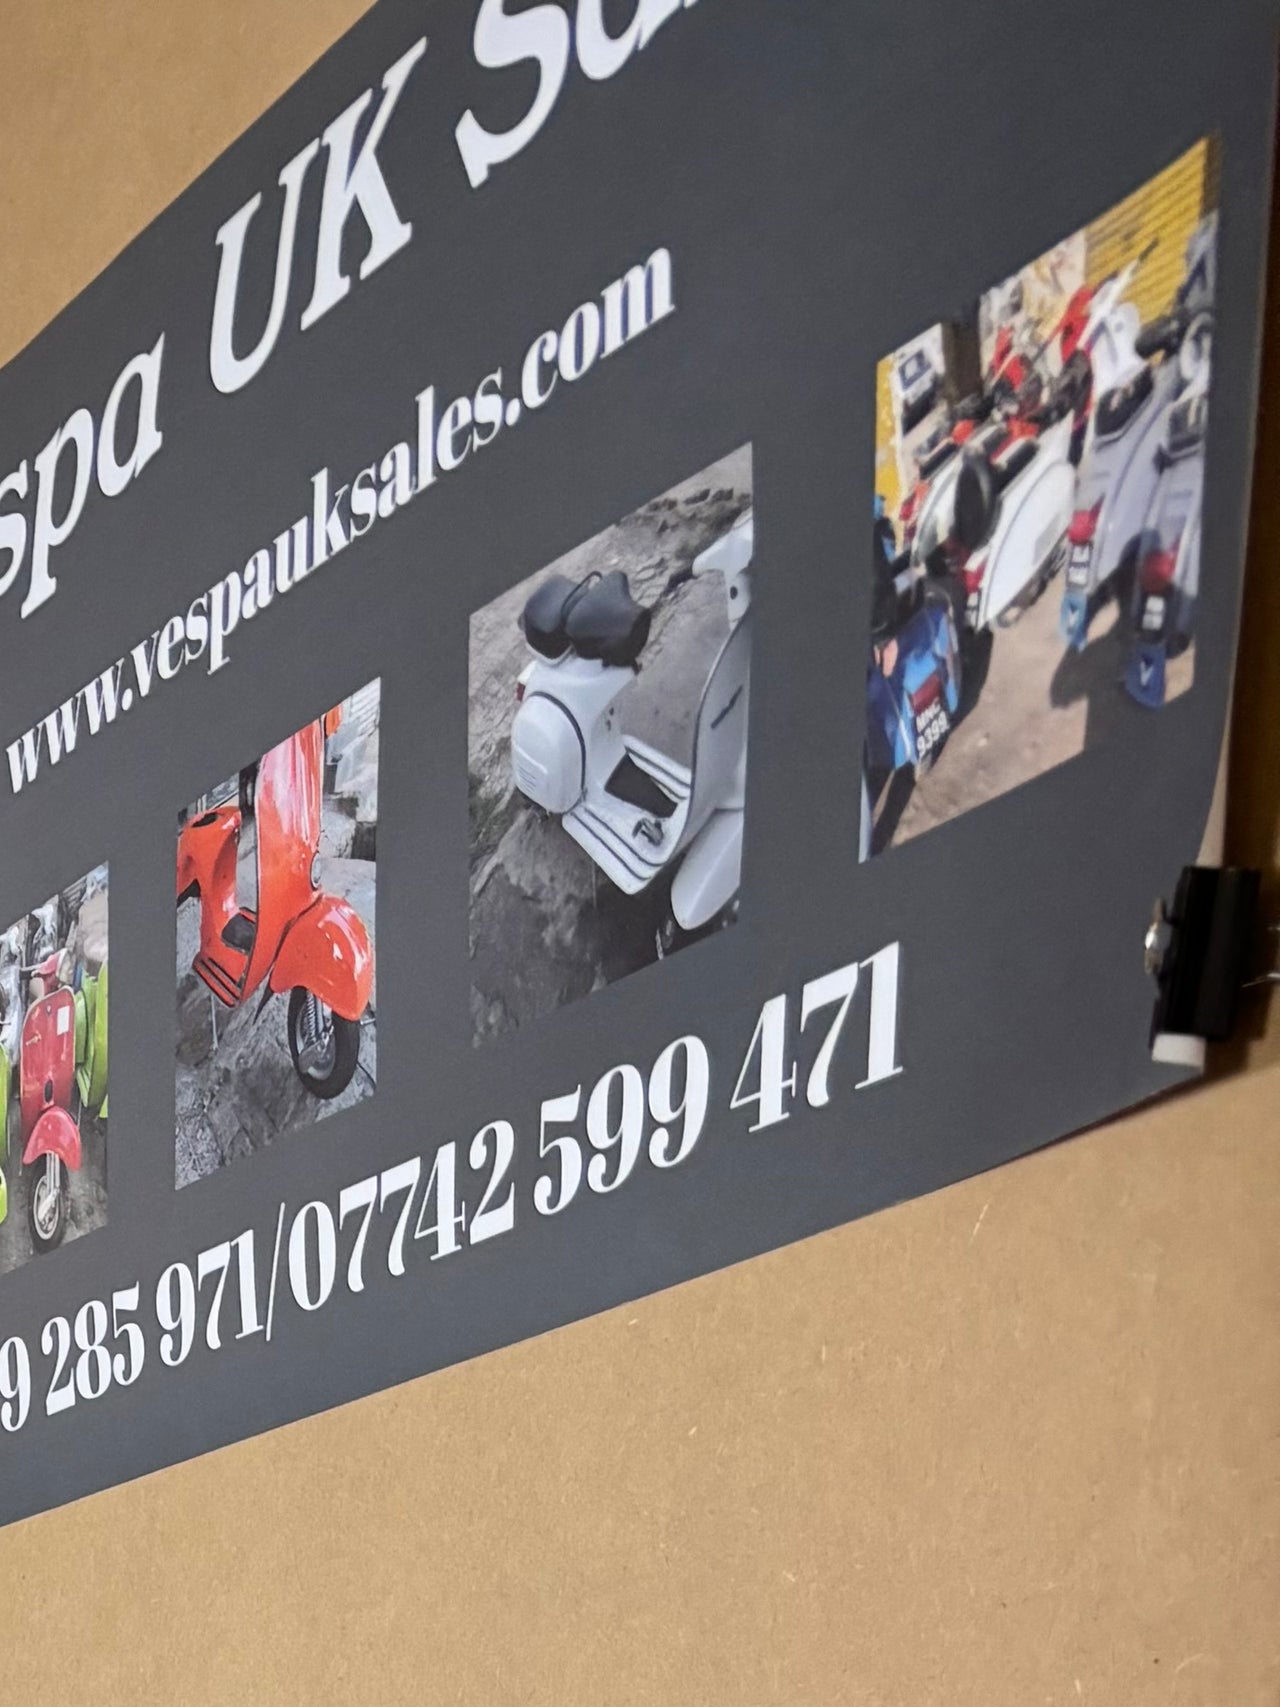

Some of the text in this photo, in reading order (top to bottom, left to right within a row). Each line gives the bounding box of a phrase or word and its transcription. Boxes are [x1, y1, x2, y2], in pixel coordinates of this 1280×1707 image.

[209, 36, 428, 394] UK
[5, 247, 676, 795] www.vespauksales.com
[40, 1280, 146, 1417] 285
[154, 1119, 516, 1368] 971/07742
[532, 1034, 711, 1216] 599
[728, 940, 904, 1134] 471
